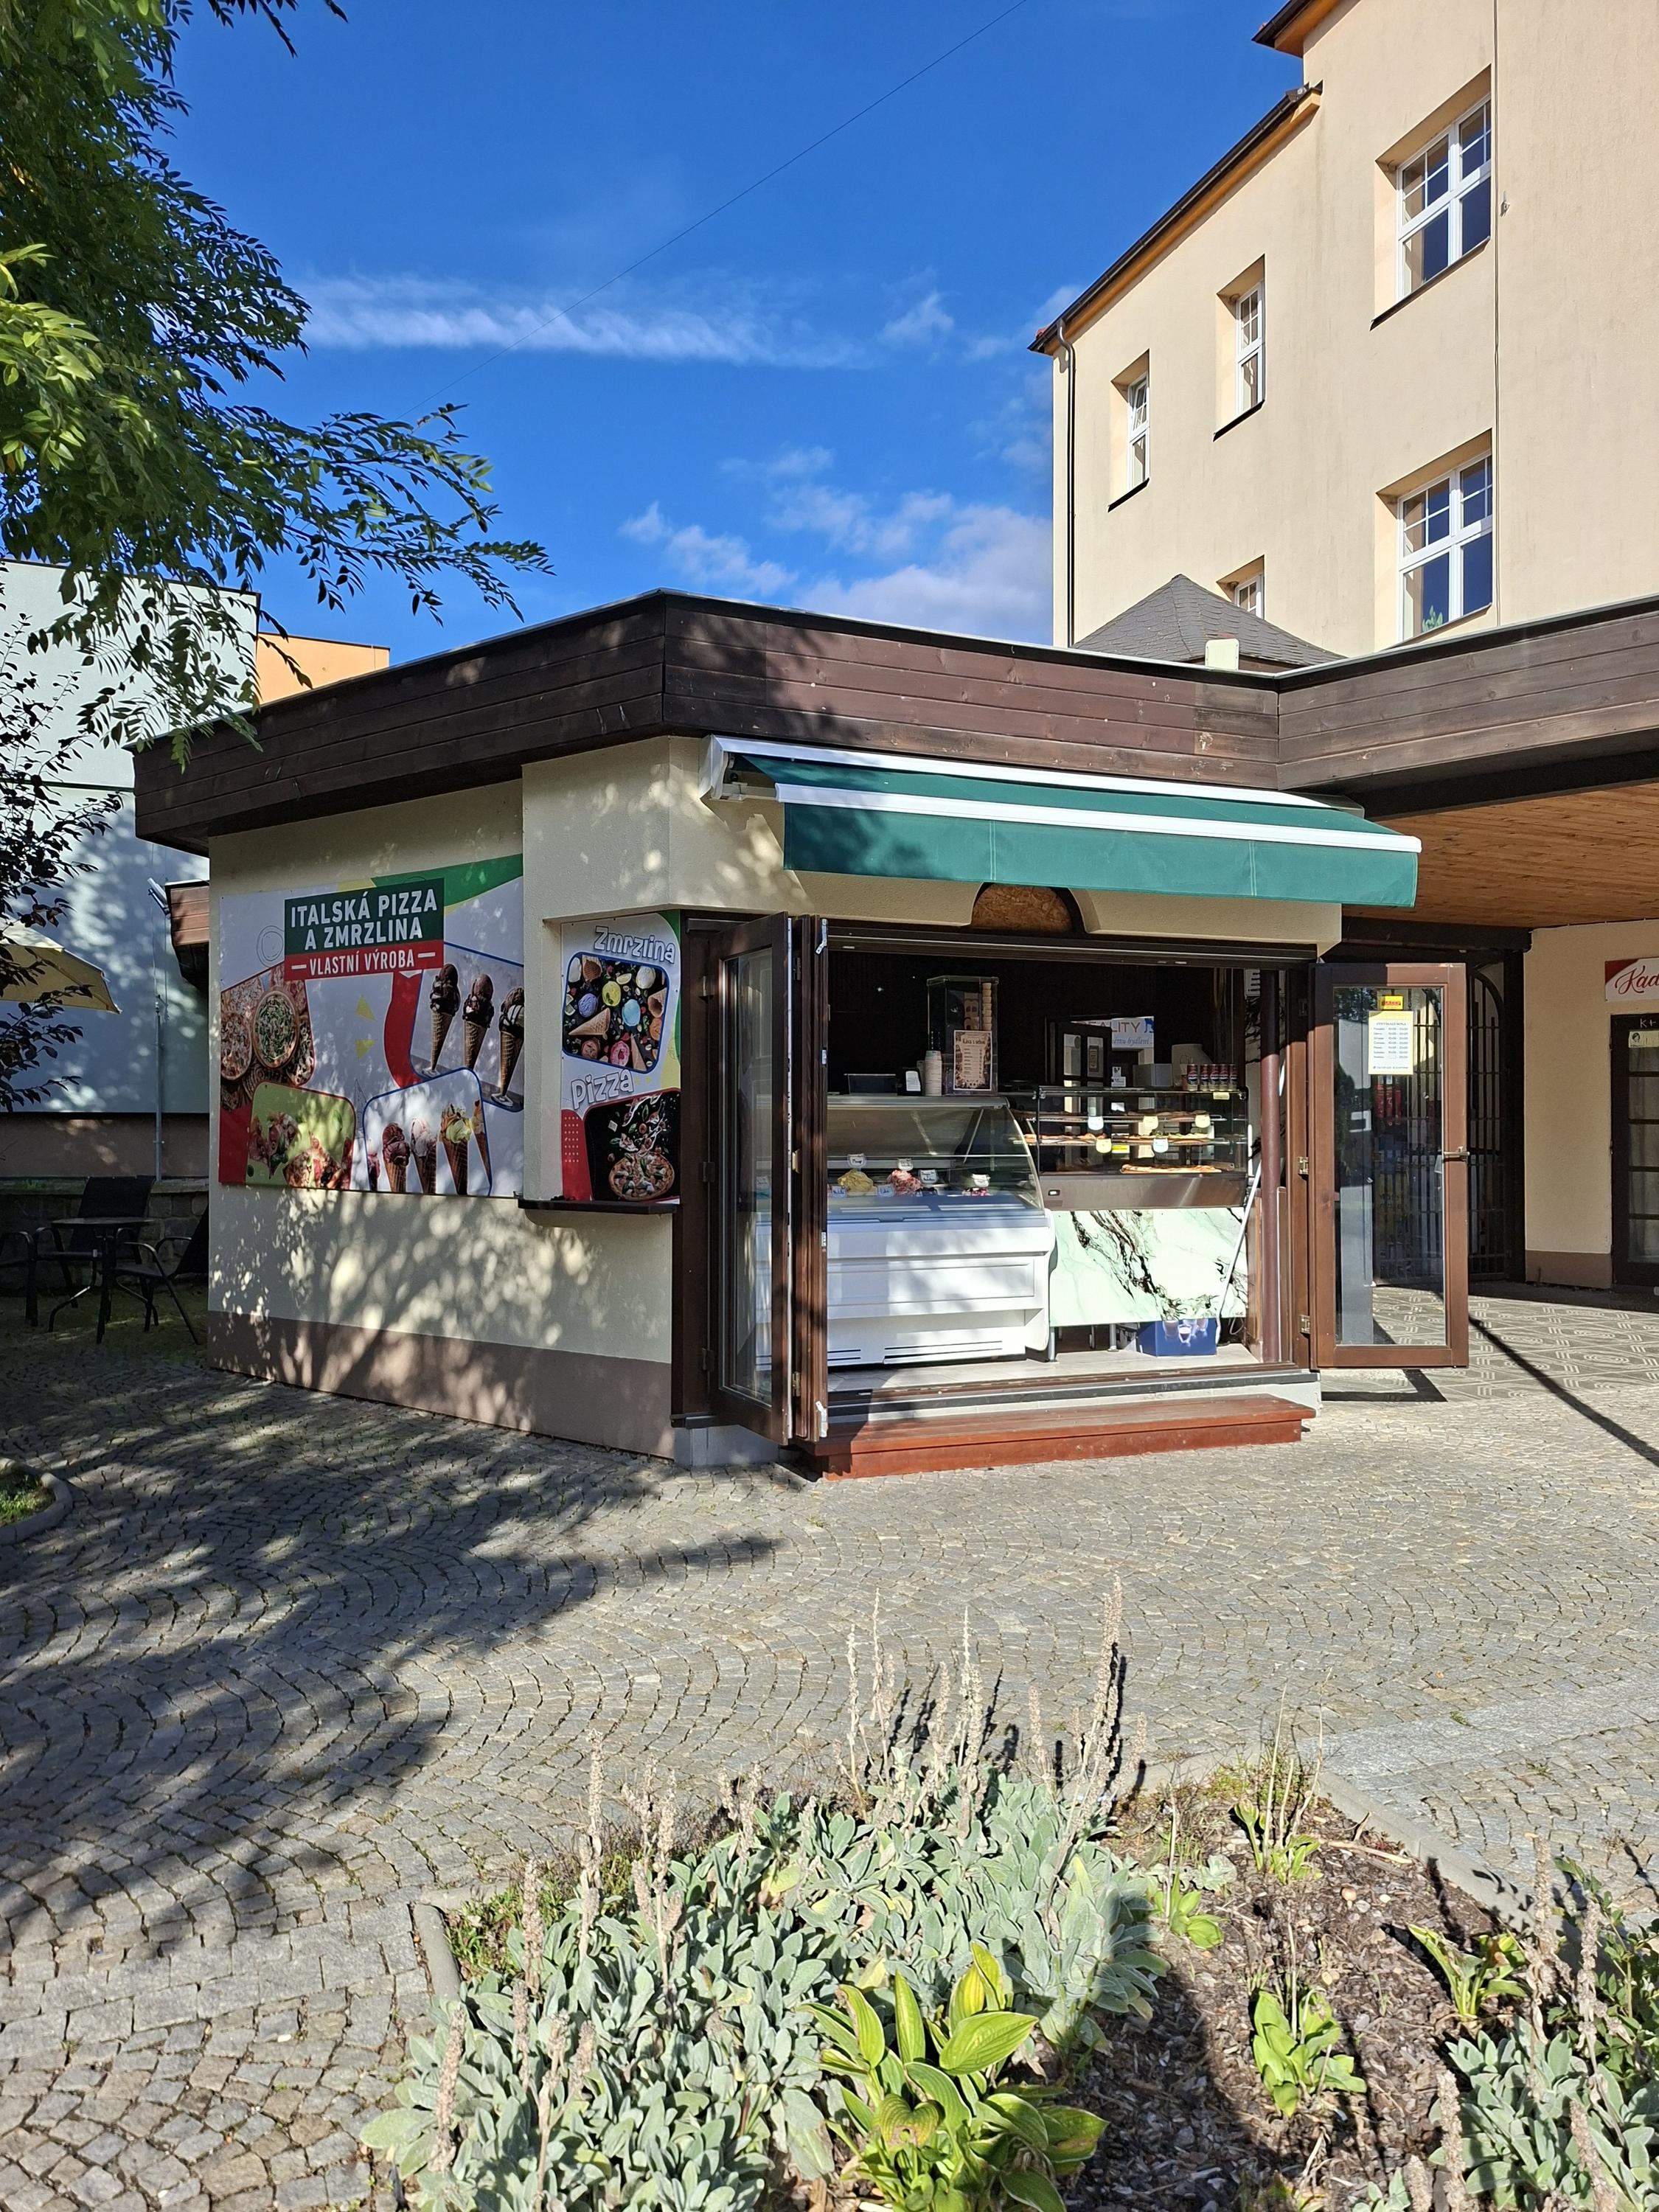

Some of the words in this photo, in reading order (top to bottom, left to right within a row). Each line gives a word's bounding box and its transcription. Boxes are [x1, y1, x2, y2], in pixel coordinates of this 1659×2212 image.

[291, 891, 370, 928] ITALSKÁ
[378, 888, 437, 917] PIZZA
[305, 929, 316, 950] A
[324, 917, 422, 949] ZMRZLINA
[594, 925, 676, 964] Zmrzlina
[310, 950, 360, 976] VLASTNÍ
[364, 948, 414, 970] VÝROBA
